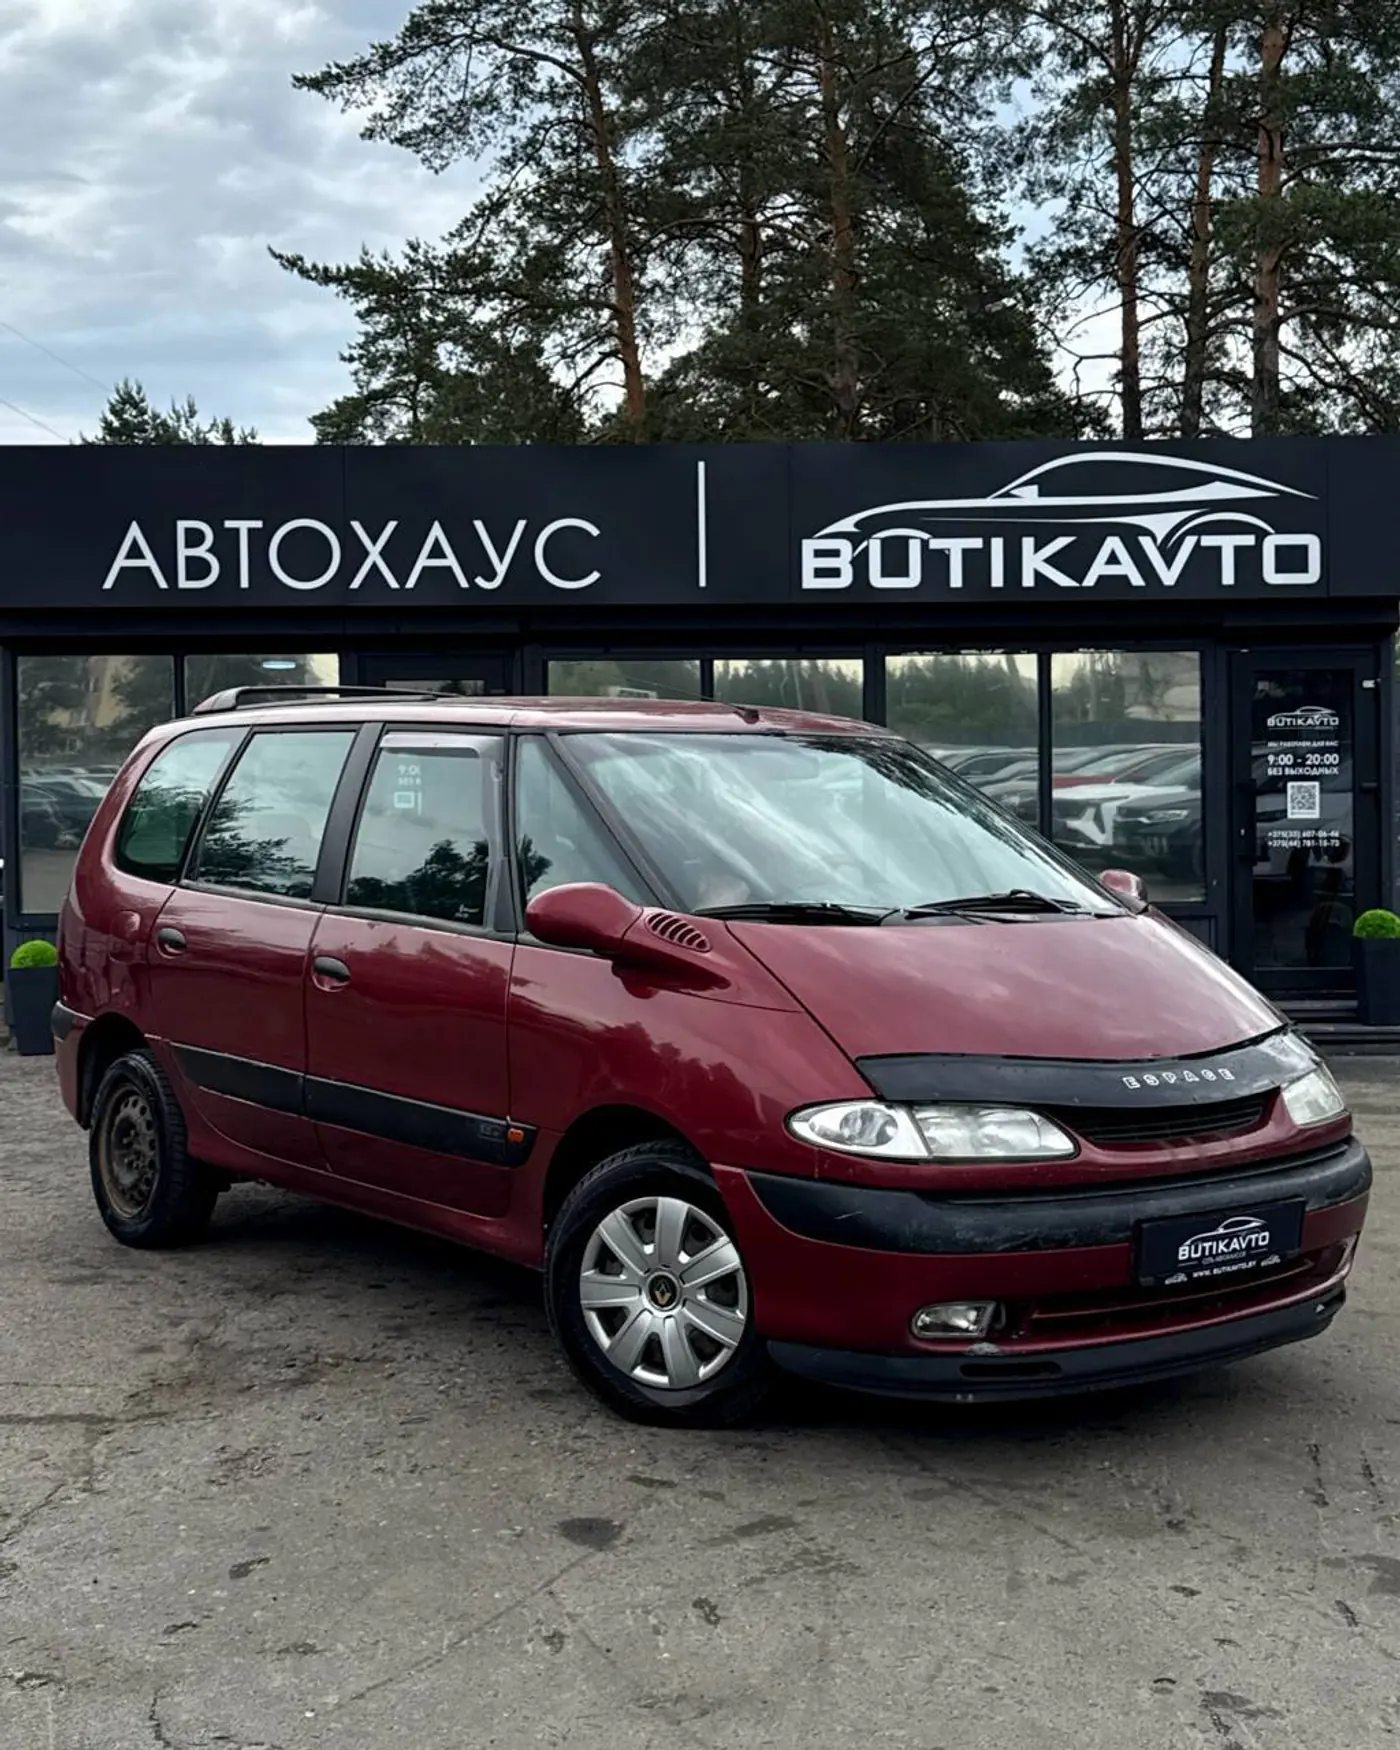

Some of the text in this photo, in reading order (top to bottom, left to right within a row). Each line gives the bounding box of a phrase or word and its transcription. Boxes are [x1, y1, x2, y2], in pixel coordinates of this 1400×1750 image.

[102, 518, 601, 590] АВТОХАУС
[801, 532, 1321, 589] BUTIKAVTO
[1267, 717, 1339, 727] BUTIKAVTO
[1267, 754, 1293, 766] 9:00
[1305, 753, 1340, 765] 20:00
[1267, 767, 1339, 776] БЕЗ ВЫХОДНЫХ
[1122, 1068, 1235, 1089] ESPACE
[1177, 1231, 1270, 1260] BUTIKAVTO
